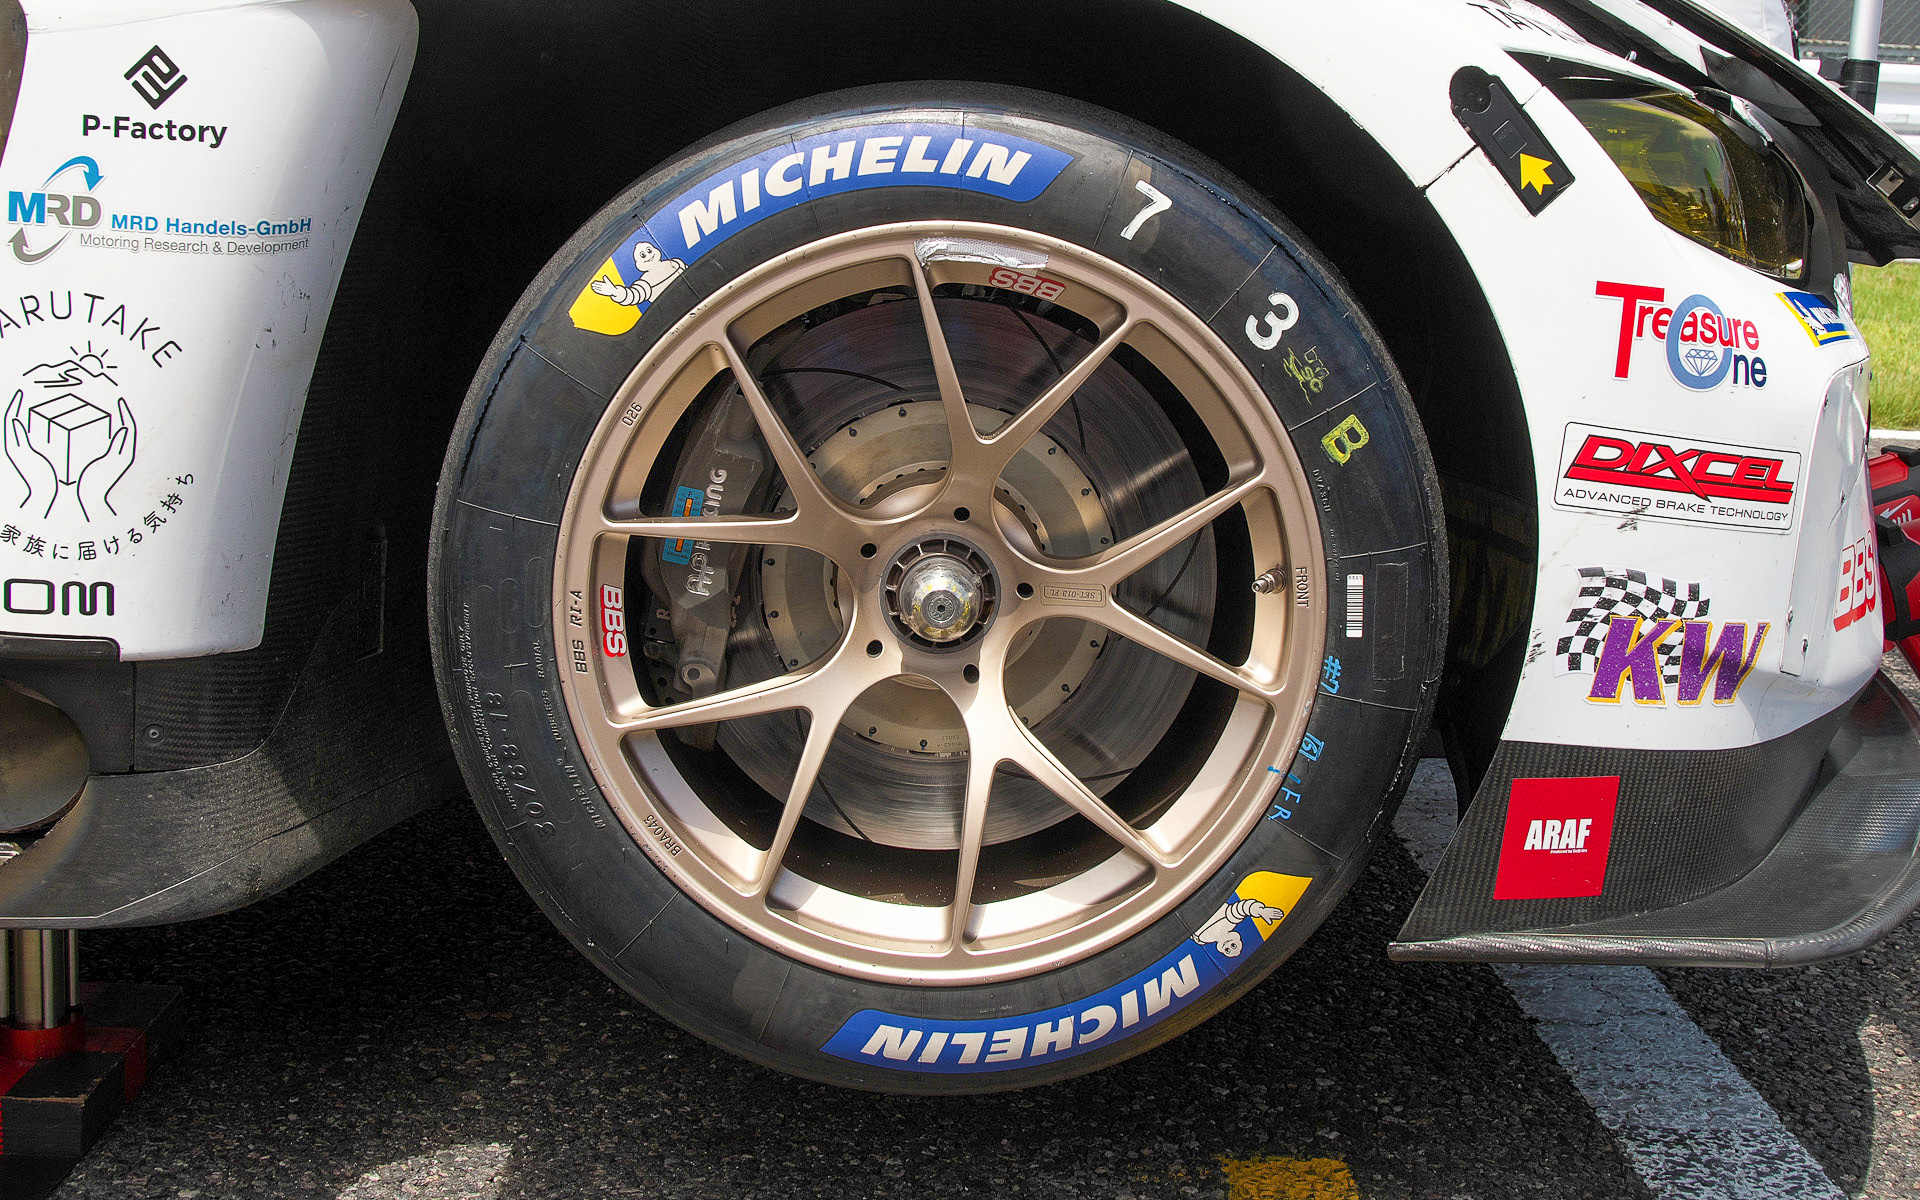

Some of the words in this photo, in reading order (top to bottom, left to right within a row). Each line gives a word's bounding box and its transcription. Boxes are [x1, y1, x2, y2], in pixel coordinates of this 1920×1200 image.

[82, 115, 227, 148] P-Factory
[8, 191, 101, 226] MRD
[679, 135, 1033, 250] MICHELIN
[80, 233, 139, 252] Motoring
[144, 238, 208, 253] Research
[213, 242, 223, 253] &
[227, 238, 309, 255] Development
[111, 214, 159, 232] MRD
[166, 217, 311, 236] Handels-GmbH
[990, 269, 1065, 301] BBS
[1120, 180, 1172, 239] 7
[1245, 292, 1299, 350] 3
[1596, 281, 1760, 379] Treasure
[1666, 294, 1768, 390] One
[621, 402, 642, 427] 026
[1321, 414, 1370, 466] B
[1563, 434, 1796, 503] DIXCEL
[1564, 487, 1651, 507] ADVANCED
[1656, 500, 1706, 513] BRAKE
[1710, 506, 1789, 522] TECHNOLOGY
[1295, 566, 1310, 608] FRONT
[1833, 530, 1876, 632] BBS
[570, 590, 584, 628] RI-A
[600, 583, 627, 658] BBS
[531, 639, 545, 679] RADIAL
[571, 639, 589, 675] BBS
[1321, 655, 1342, 694] #7
[1585, 615, 1771, 706] KW
[539, 688, 563, 742] TUBELESS
[643, 814, 682, 857] BRA043
[1524, 818, 1592, 850] ARAF
[861, 954, 1201, 1064] MICHELIN
